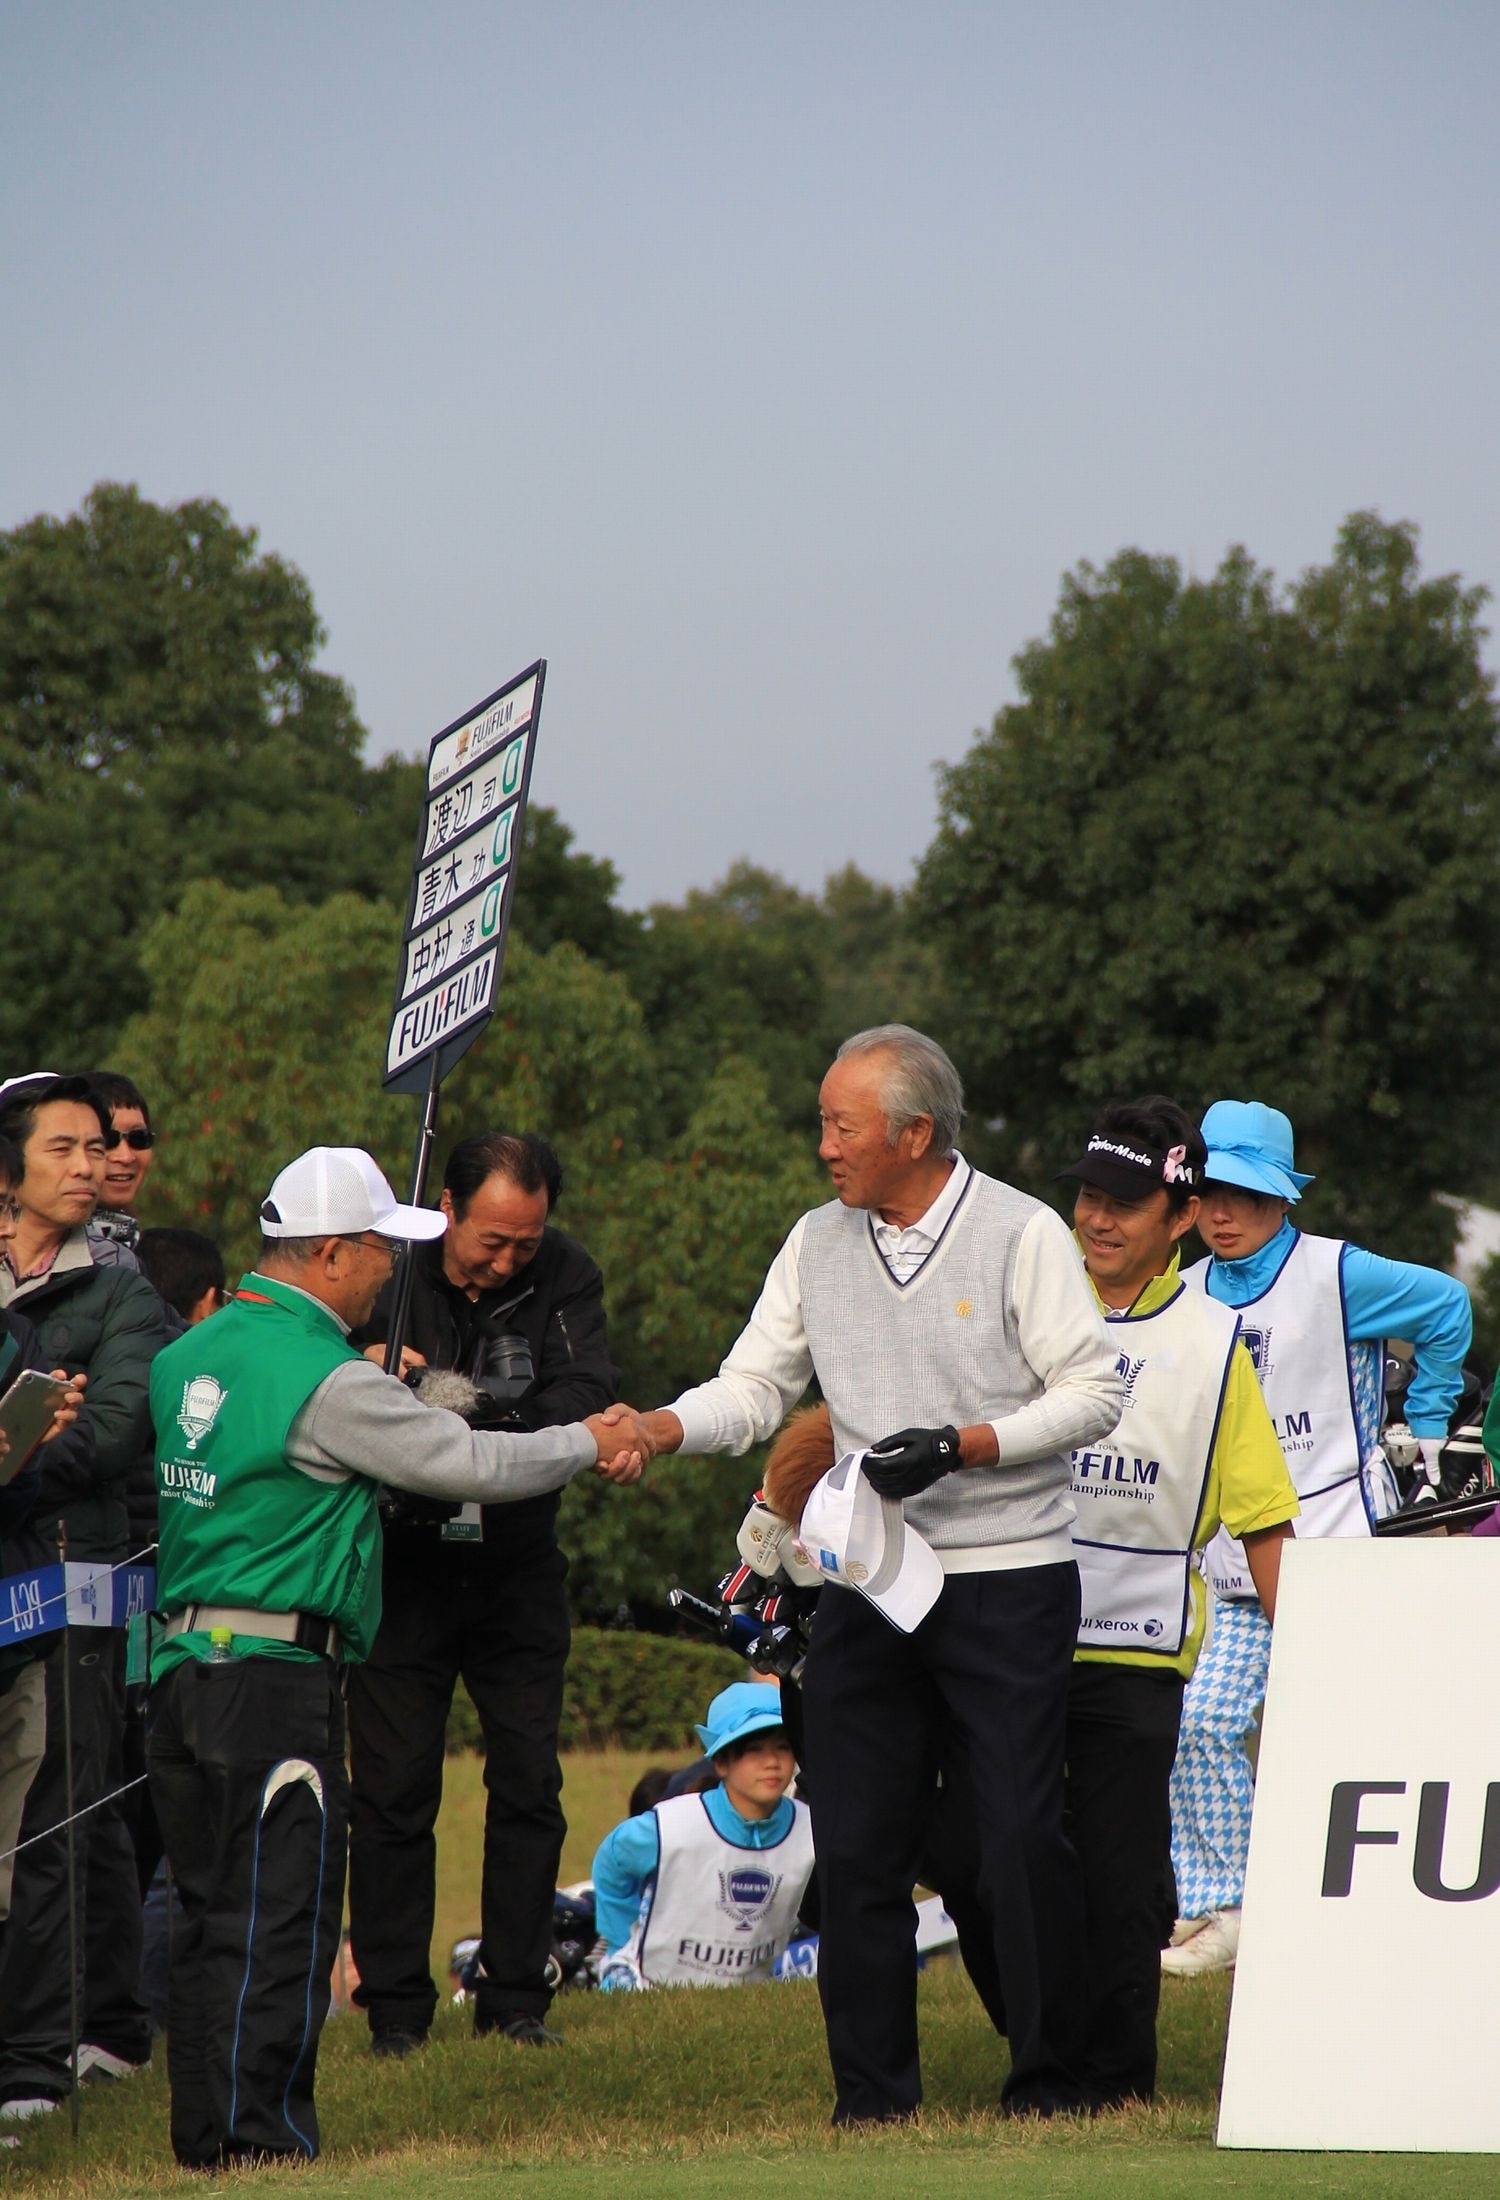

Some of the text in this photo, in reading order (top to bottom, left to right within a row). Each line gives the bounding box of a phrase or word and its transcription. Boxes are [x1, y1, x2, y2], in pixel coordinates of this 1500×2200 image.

[472, 701, 513, 747] FUJIFILM
[480, 776, 497, 815] 司
[502, 739, 523, 795] 0
[420, 810, 512, 923] 青木 功 0
[412, 919, 453, 991] 中村
[481, 882, 502, 937] 0
[398, 958, 491, 1057] FUJIFILM
[1080, 1618, 1139, 1632] JI xerox
[1321, 1781, 1500, 1902] FU
[732, 1881, 768, 1893] FUJIFILM
[678, 1939, 776, 1967] FUJIFILM
